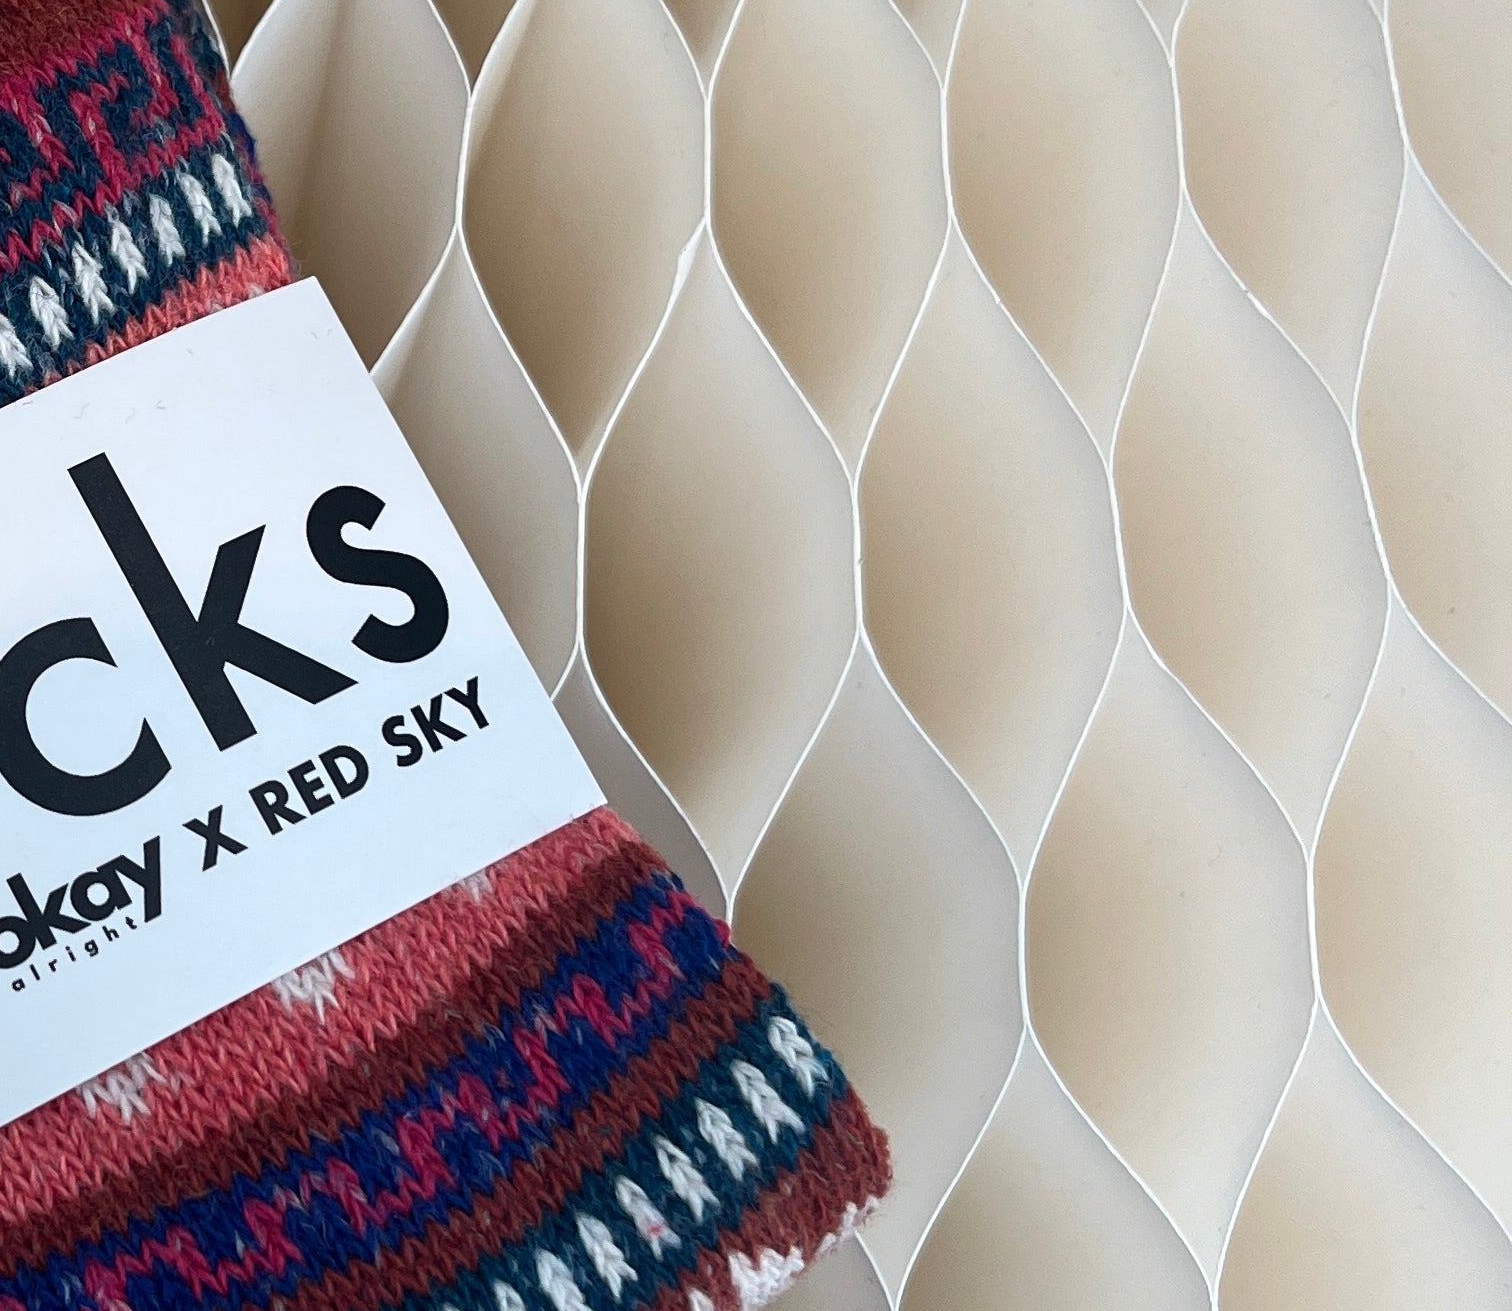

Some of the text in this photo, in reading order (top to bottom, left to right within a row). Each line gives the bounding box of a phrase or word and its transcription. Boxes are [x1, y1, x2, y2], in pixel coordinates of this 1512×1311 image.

[247, 744, 370, 837] RED
[380, 675, 491, 768] SKY
[10, 915, 139, 993] alright
